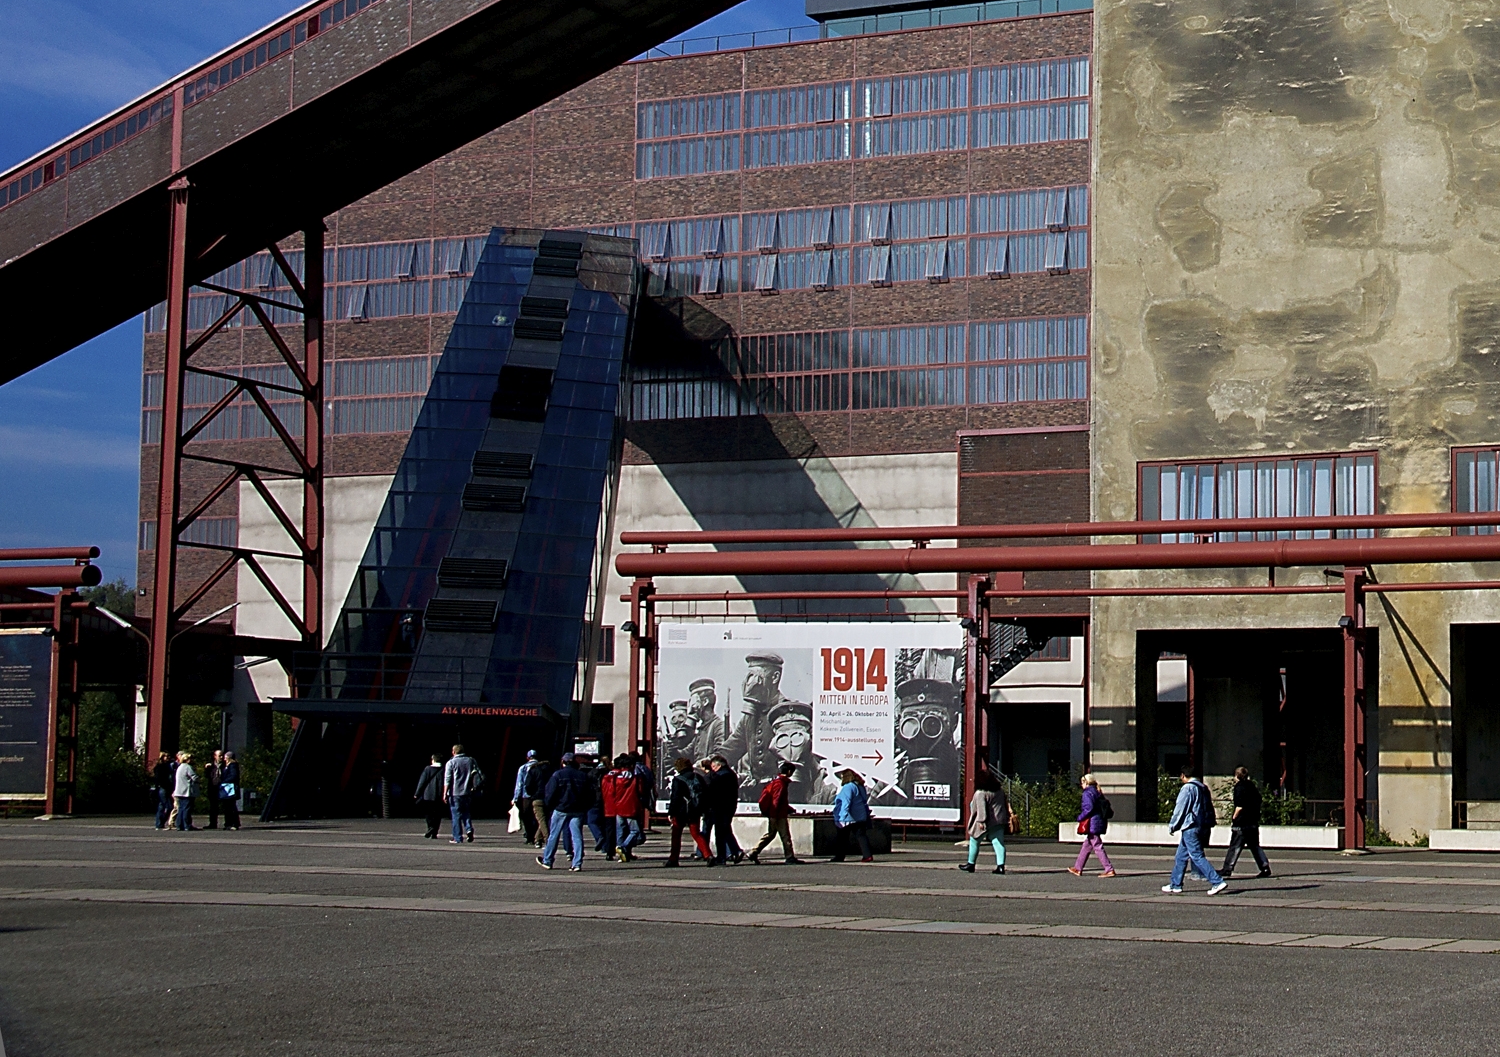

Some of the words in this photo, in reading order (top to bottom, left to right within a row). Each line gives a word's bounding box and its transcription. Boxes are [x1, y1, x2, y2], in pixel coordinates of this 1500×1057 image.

[820, 647, 888, 692] 1914
[819, 694, 847, 705] MITTEN
[849, 694, 858, 705] IN
[860, 695, 889, 705] EUROPA
[441, 706, 458, 715] A14
[461, 706, 538, 716] KOHLENWÄSCHE
[916, 786, 936, 794] LVR
